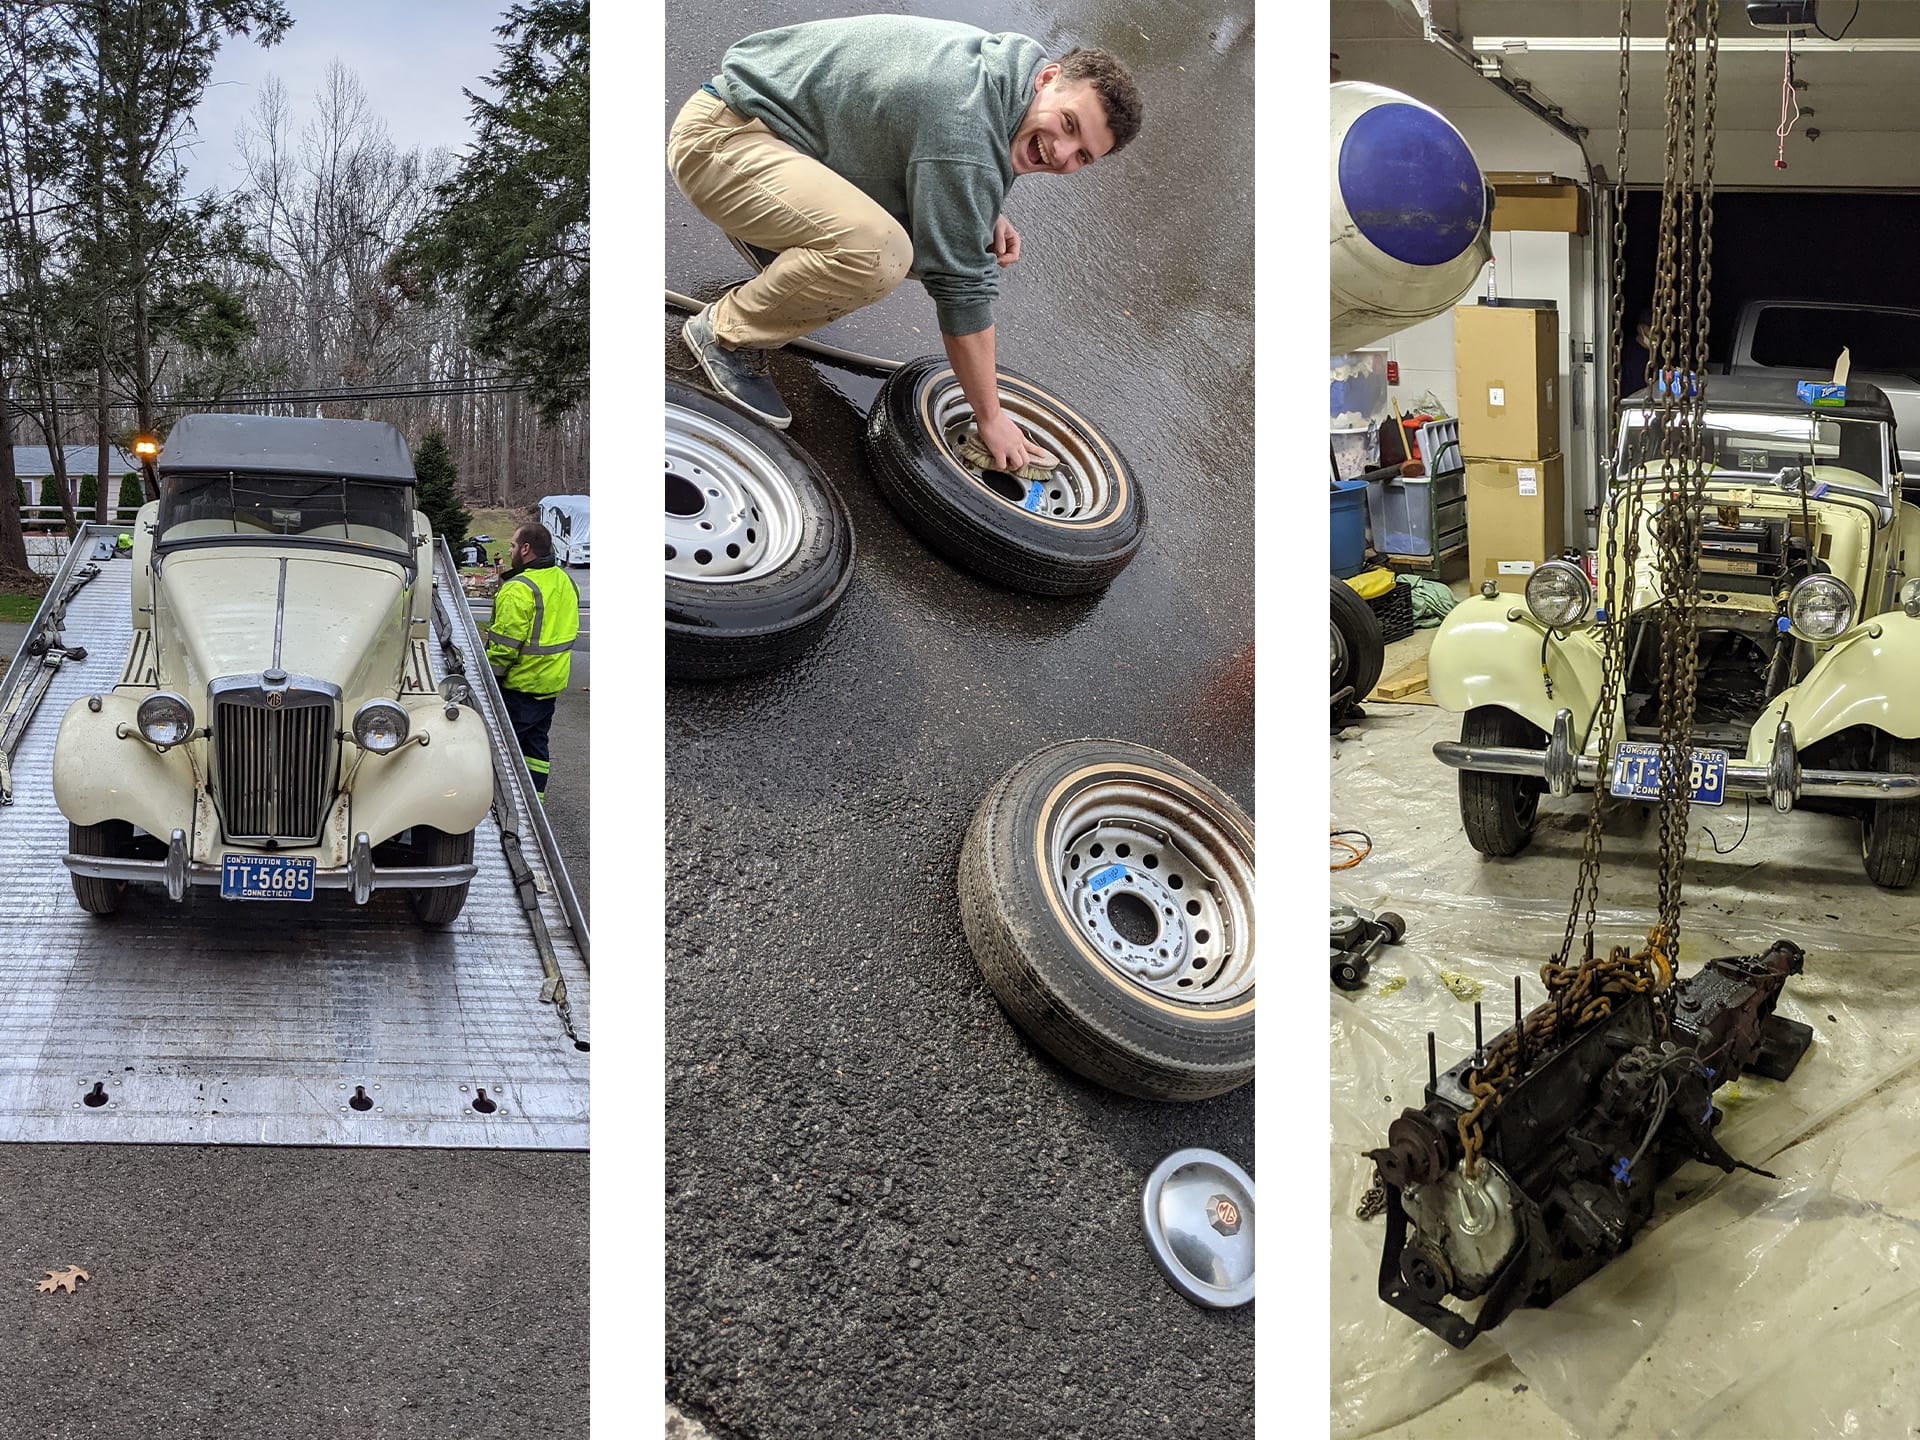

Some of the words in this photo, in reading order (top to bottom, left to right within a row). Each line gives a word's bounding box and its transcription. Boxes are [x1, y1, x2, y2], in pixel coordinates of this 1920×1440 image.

[267, 693, 281, 706] MG
[1691, 751, 1722, 762] STATE
[1620, 756, 1718, 790] TT·85
[226, 856, 280, 865] CONSTITUTION
[242, 889, 292, 897] CONNECTICUT
[1218, 1203, 1237, 1223] MG
